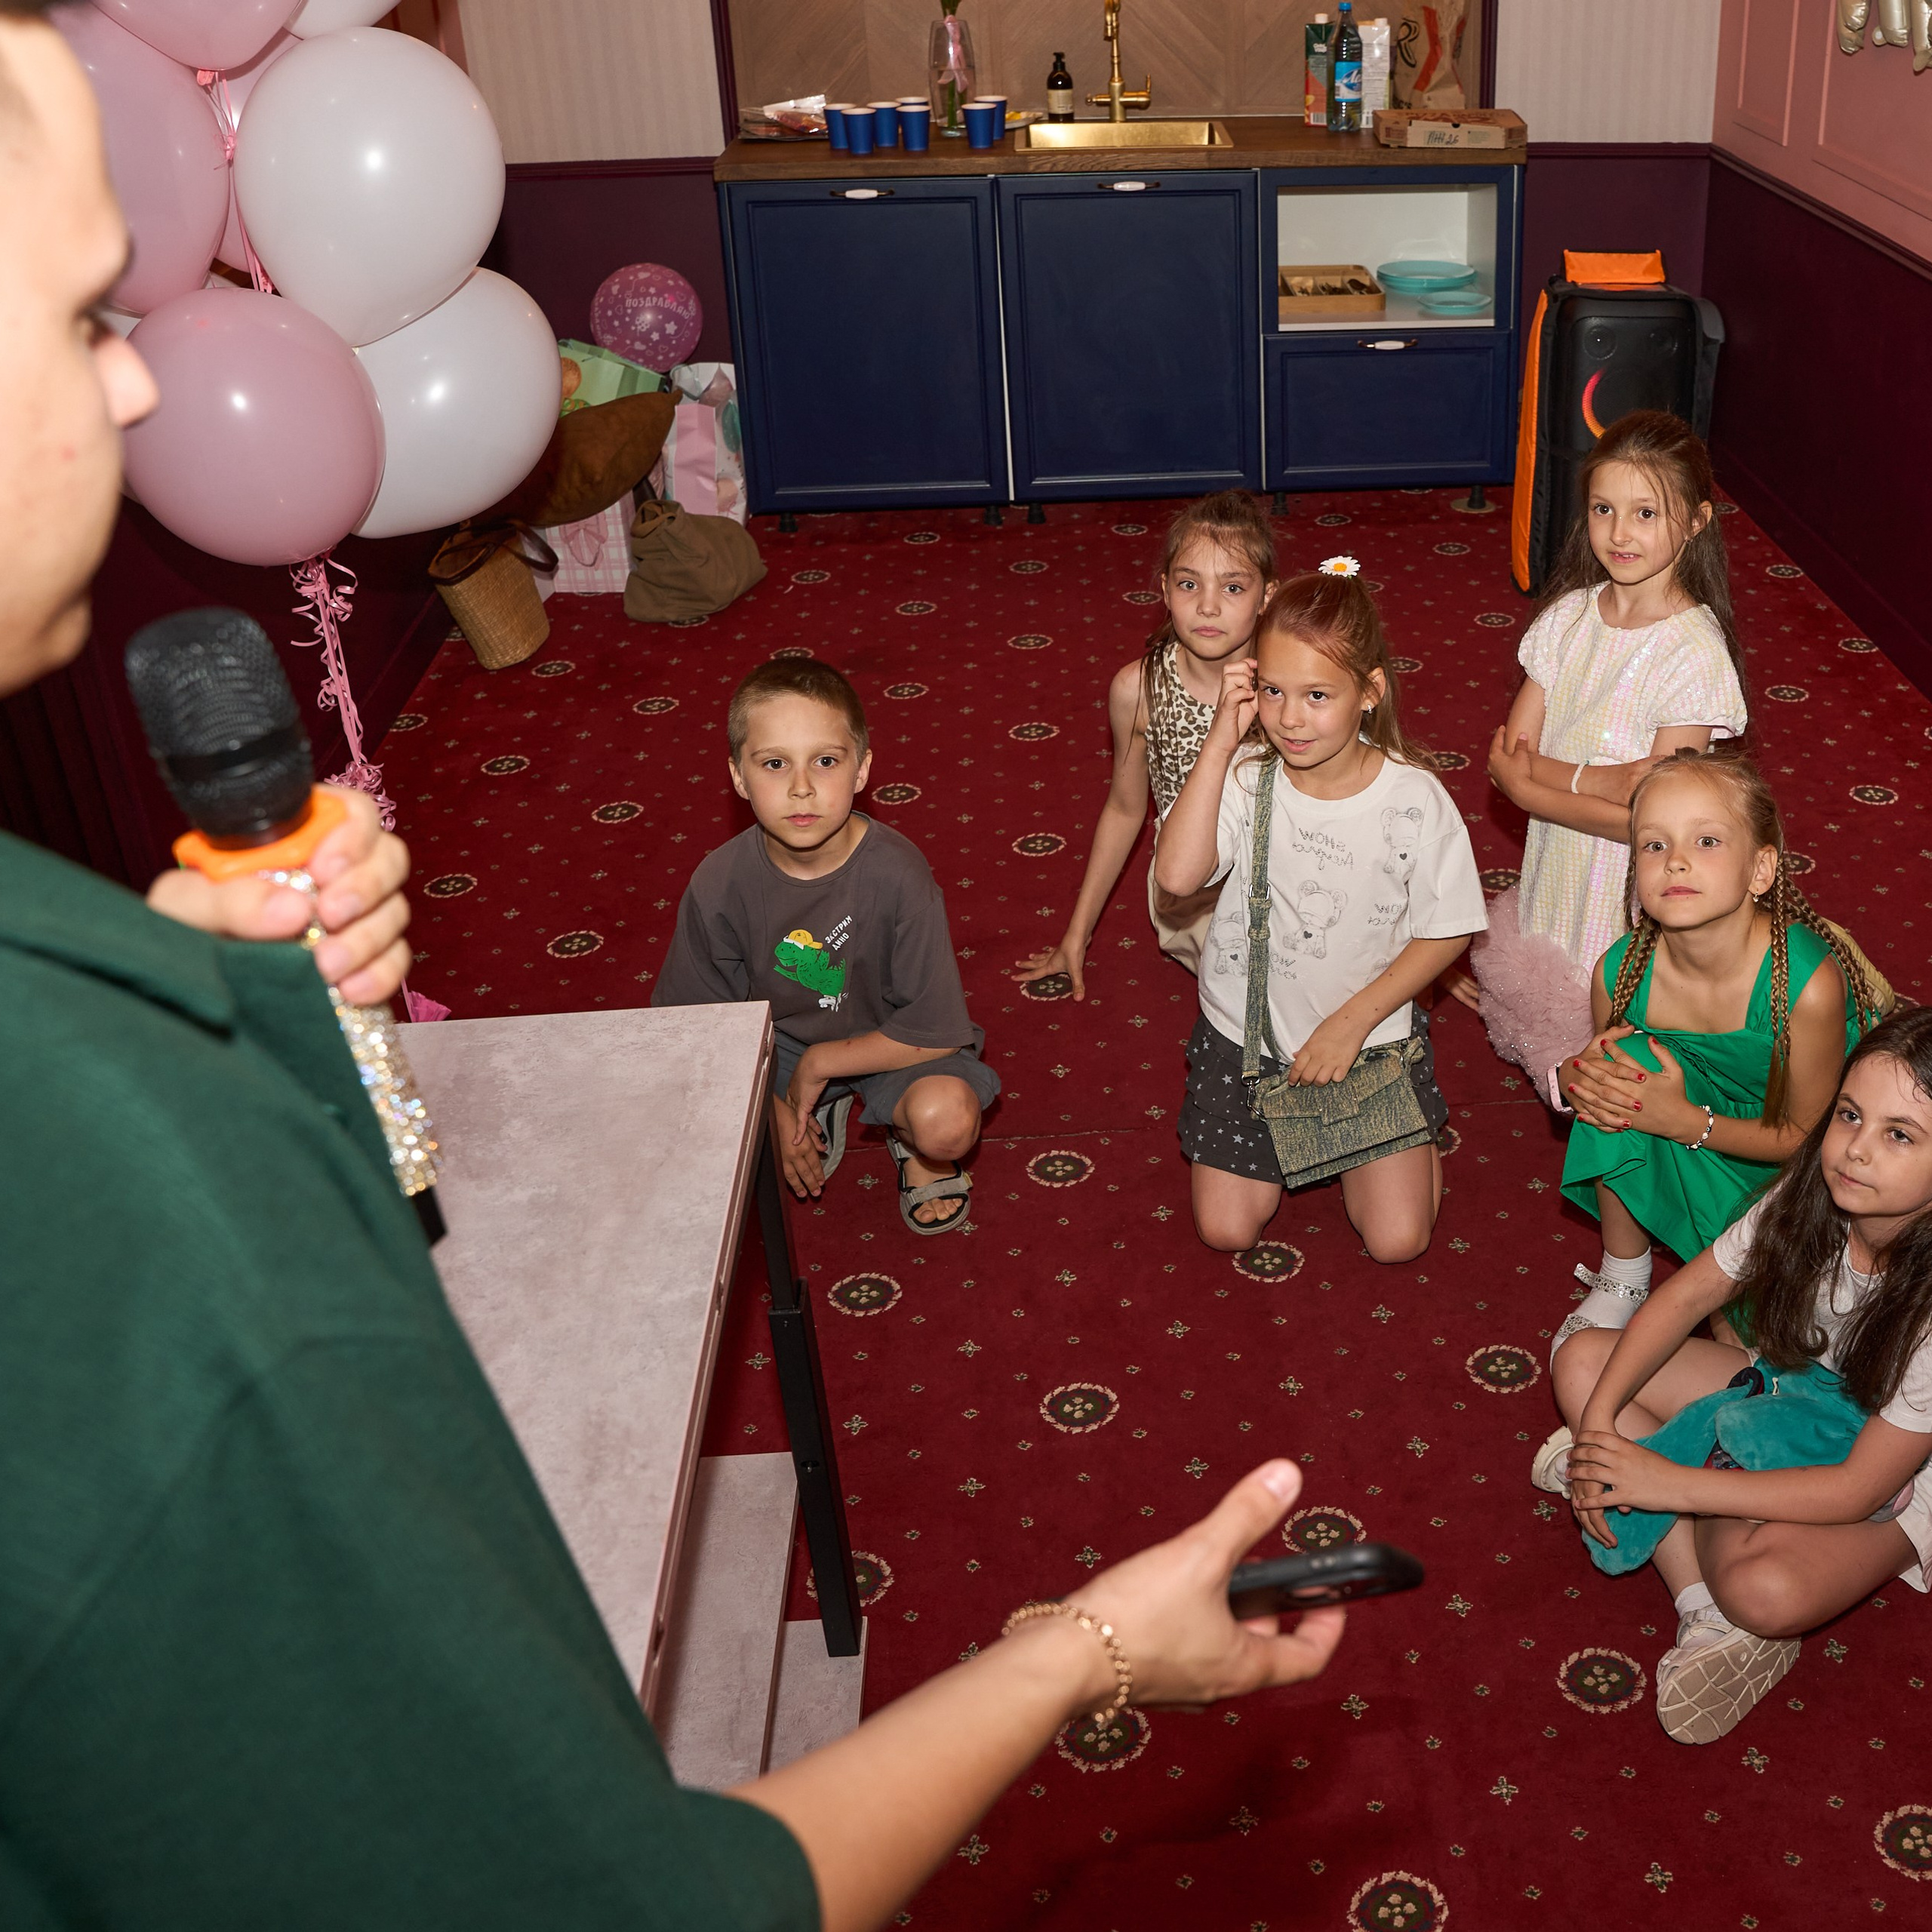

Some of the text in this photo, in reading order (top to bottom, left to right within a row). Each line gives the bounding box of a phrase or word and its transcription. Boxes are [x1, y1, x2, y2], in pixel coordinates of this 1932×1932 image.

[625, 296, 691, 320] ПОЗДРАВЛЯЮ
[824, 915, 854, 945] ЭКСТРИМ
[831, 932, 851, 951] ДИНО
